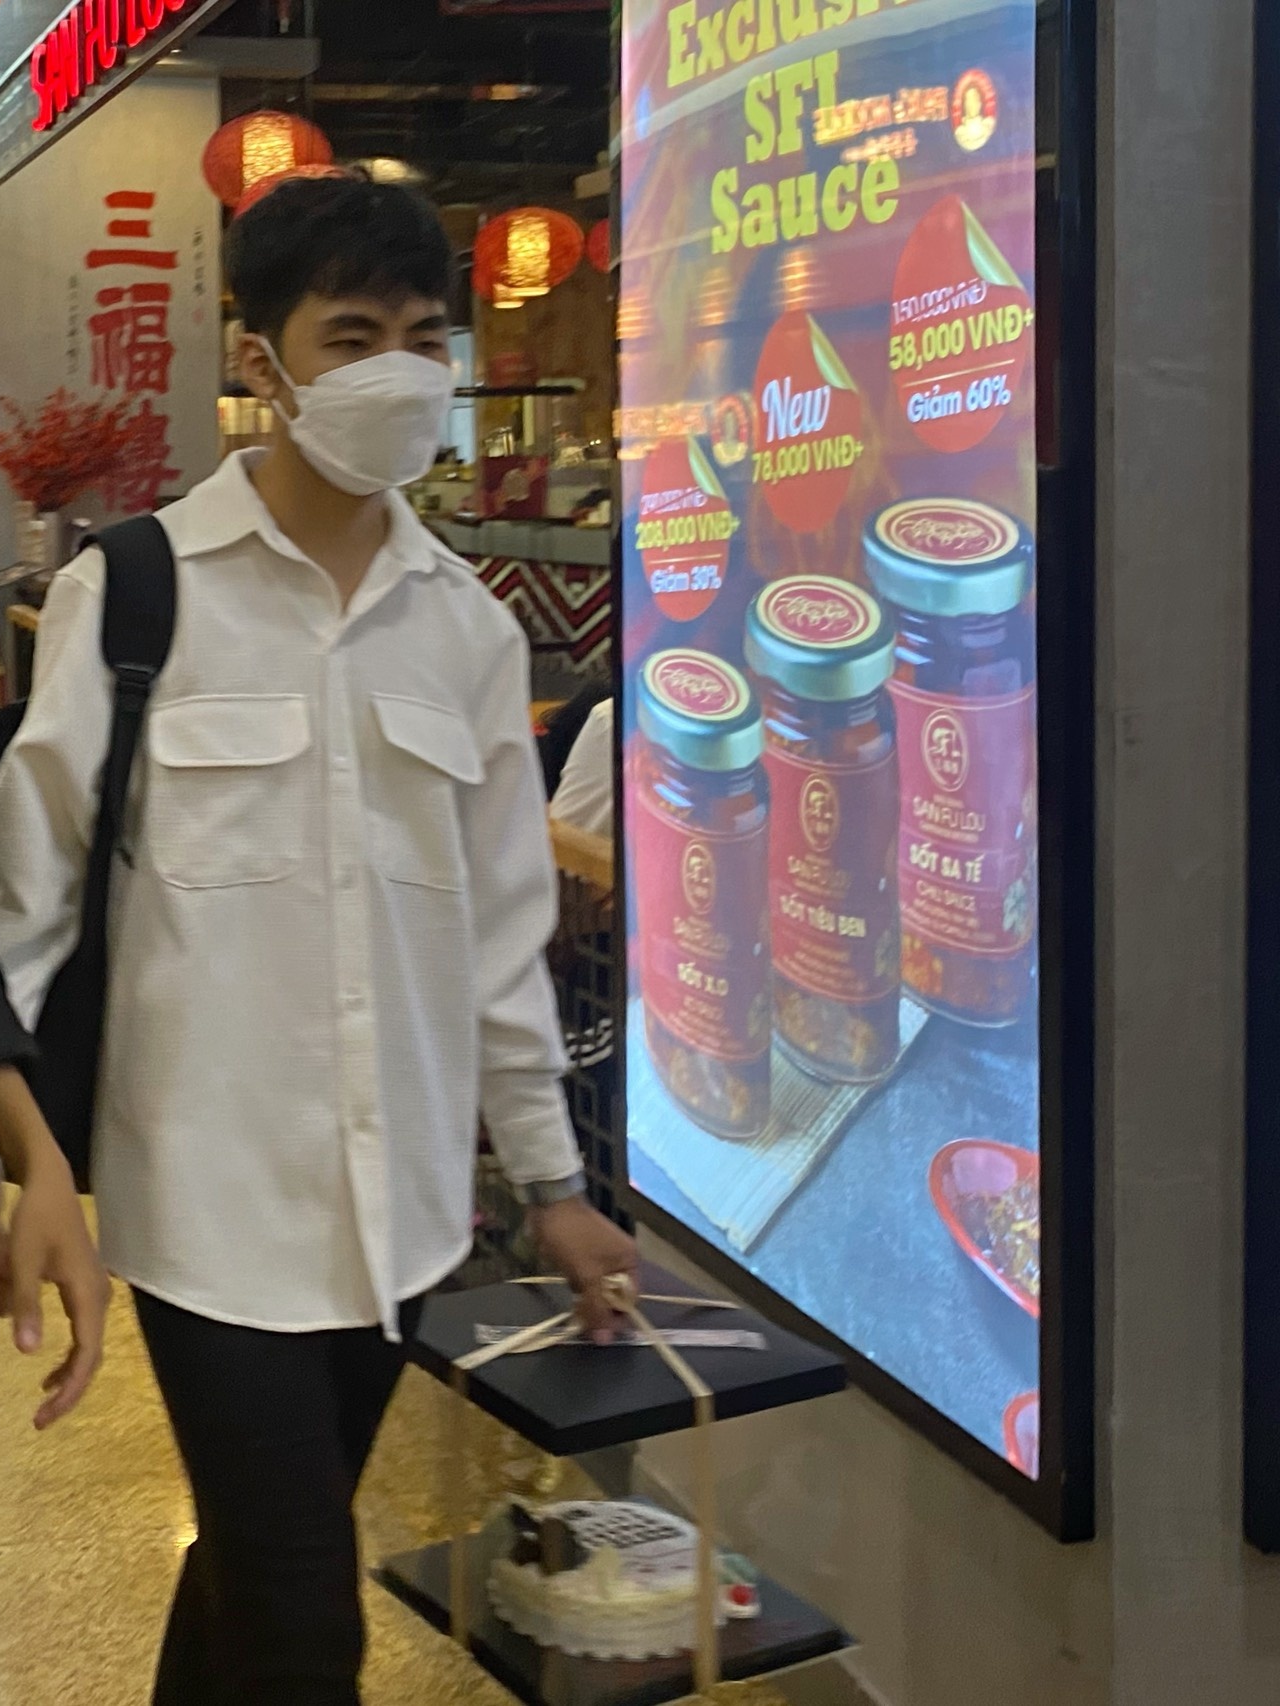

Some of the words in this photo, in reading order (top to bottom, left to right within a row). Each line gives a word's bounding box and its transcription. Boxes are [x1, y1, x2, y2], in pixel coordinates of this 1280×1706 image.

[31, 8, 80, 132] SAN
[710, 155, 901, 255] Sauce
[888, 318, 966, 371] 58,000
[762, 376, 831, 443] New
[907, 384, 962, 423] Giảm
[966, 374, 1012, 411] 60%
[751, 442, 810, 485] 78,000
